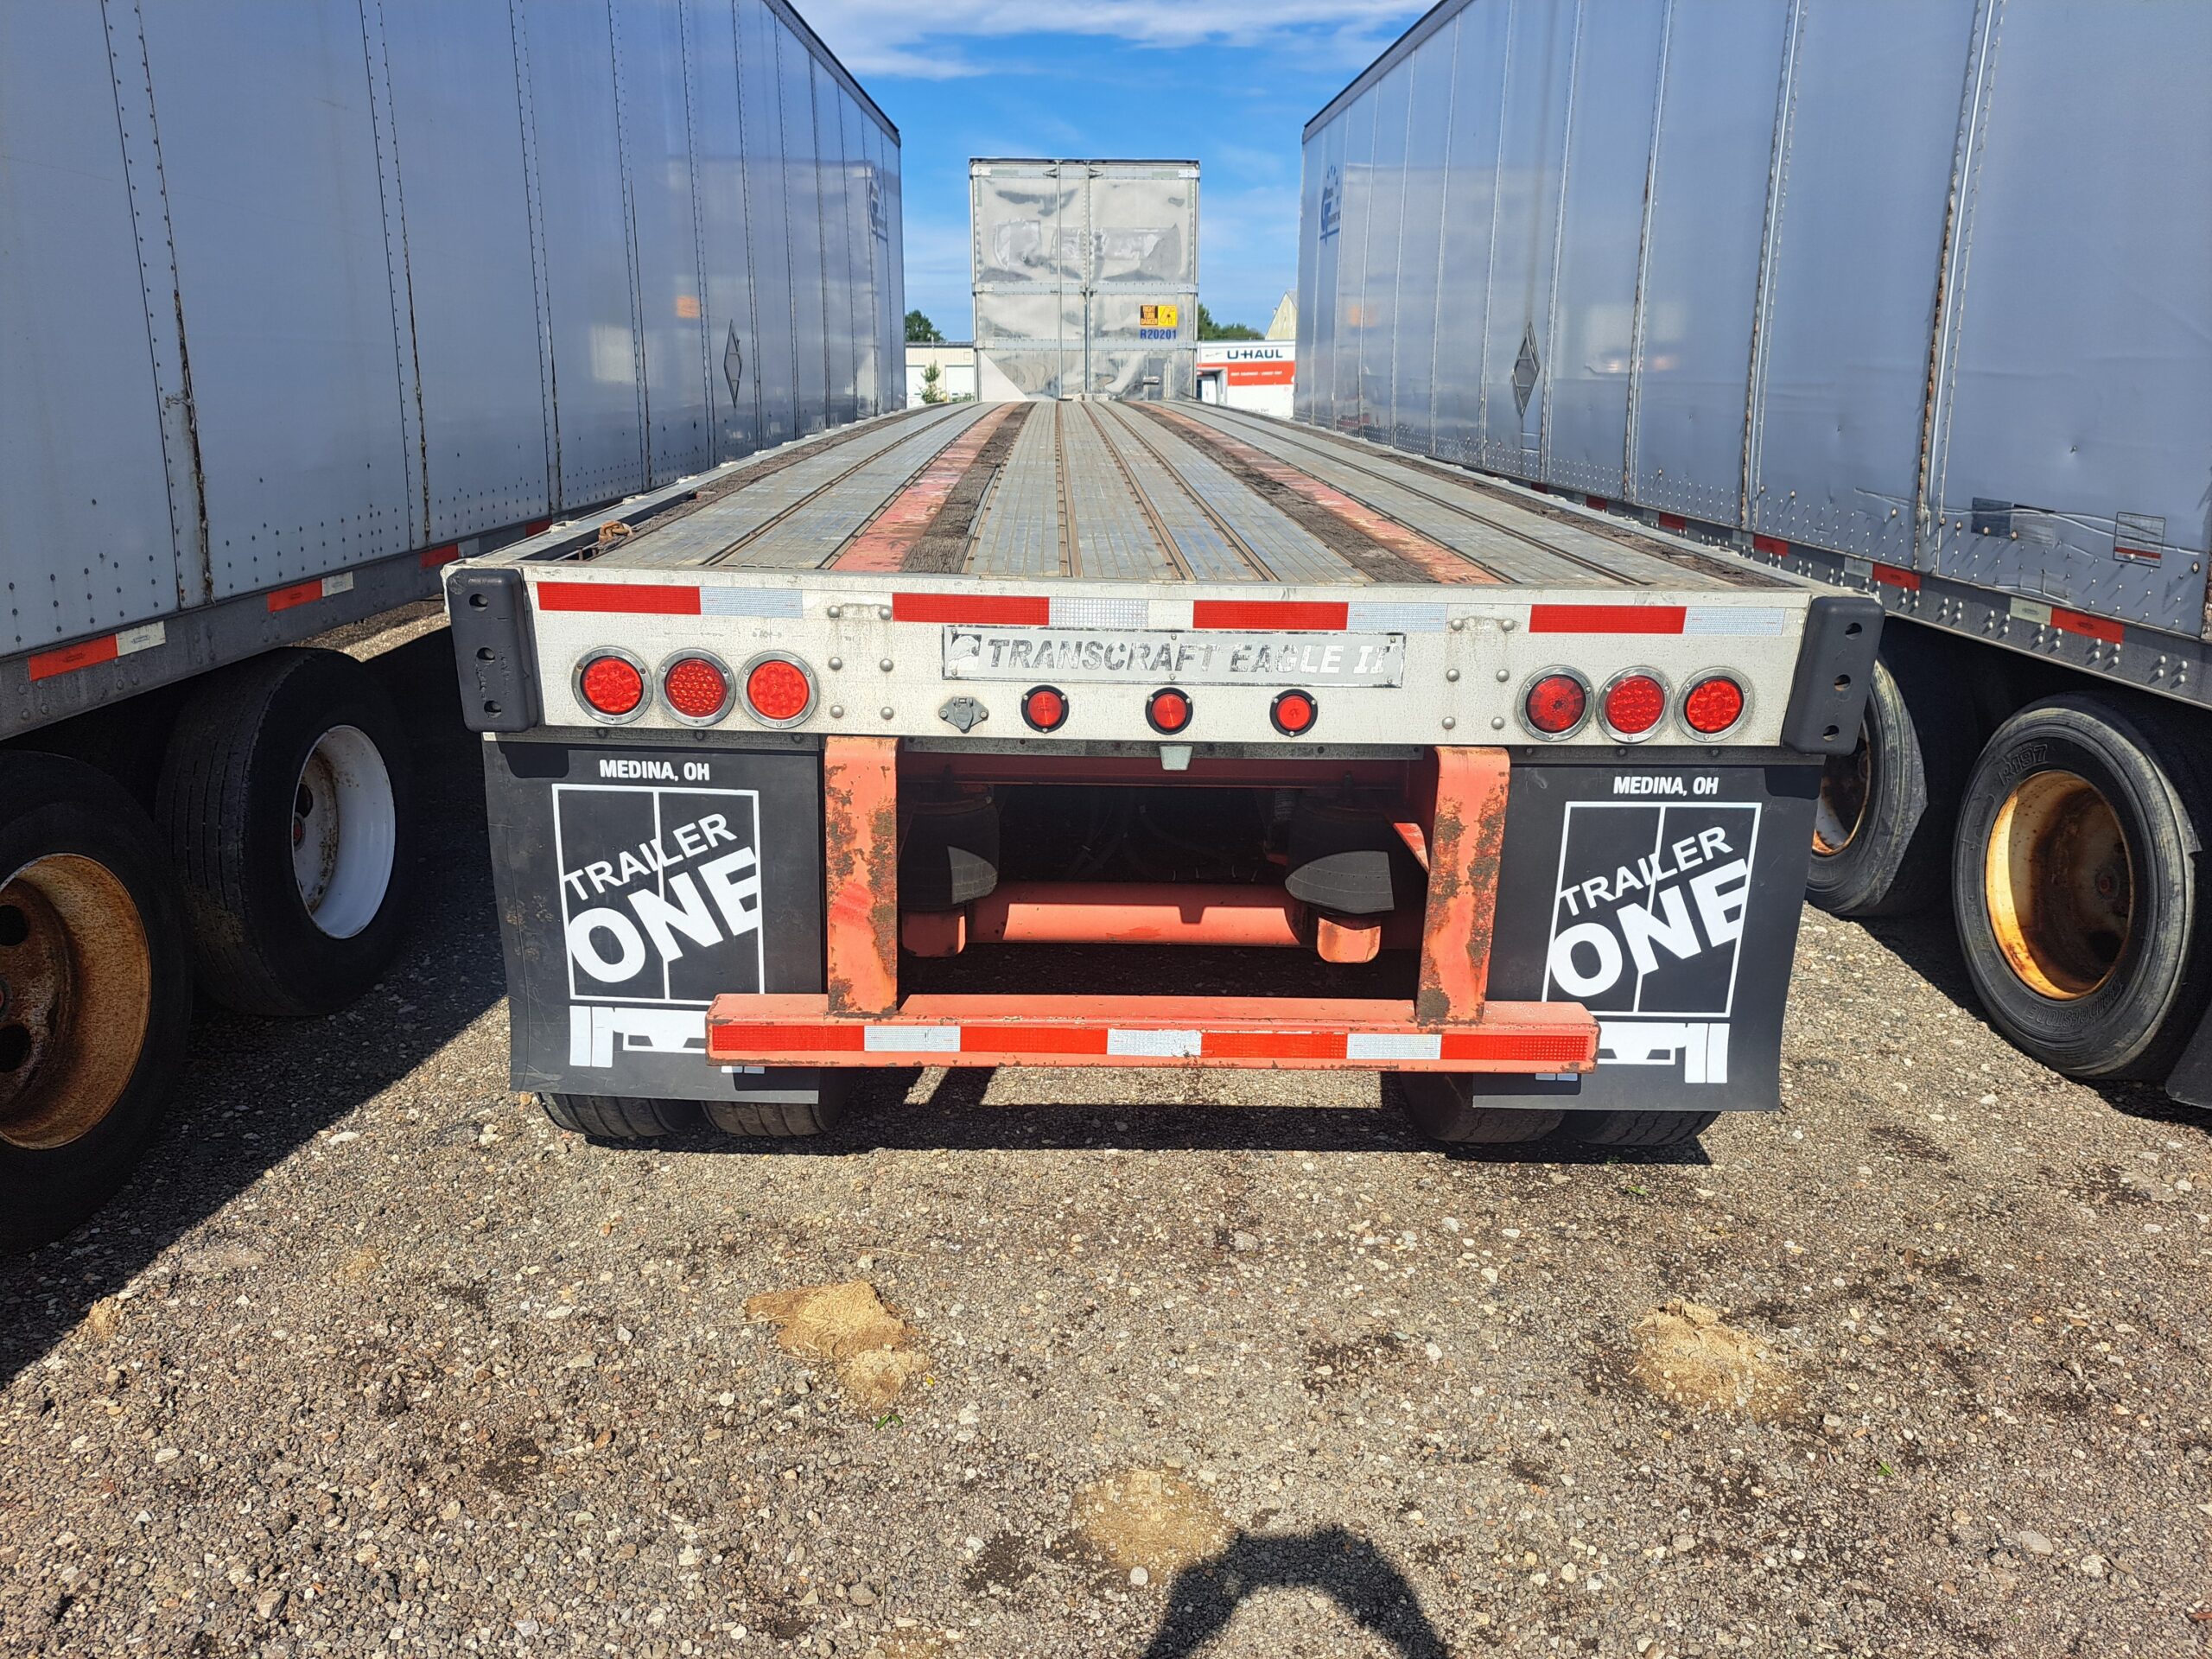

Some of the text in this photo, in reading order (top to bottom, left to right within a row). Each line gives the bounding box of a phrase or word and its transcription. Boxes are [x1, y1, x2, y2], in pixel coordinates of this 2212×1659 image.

[1140, 328, 1177, 340] R20201
[1227, 349, 1283, 359] U-HAUL
[988, 638, 1391, 674] TRANSCRAFT EAGLE II
[599, 759, 710, 782] MEDINA, OH
[1613, 776, 1719, 797] MEDINA, OH
[564, 812, 737, 900] TRAILER
[1559, 826, 1733, 916] TRAILER
[569, 846, 759, 982] ONE
[1549, 858, 1747, 997] ONE
